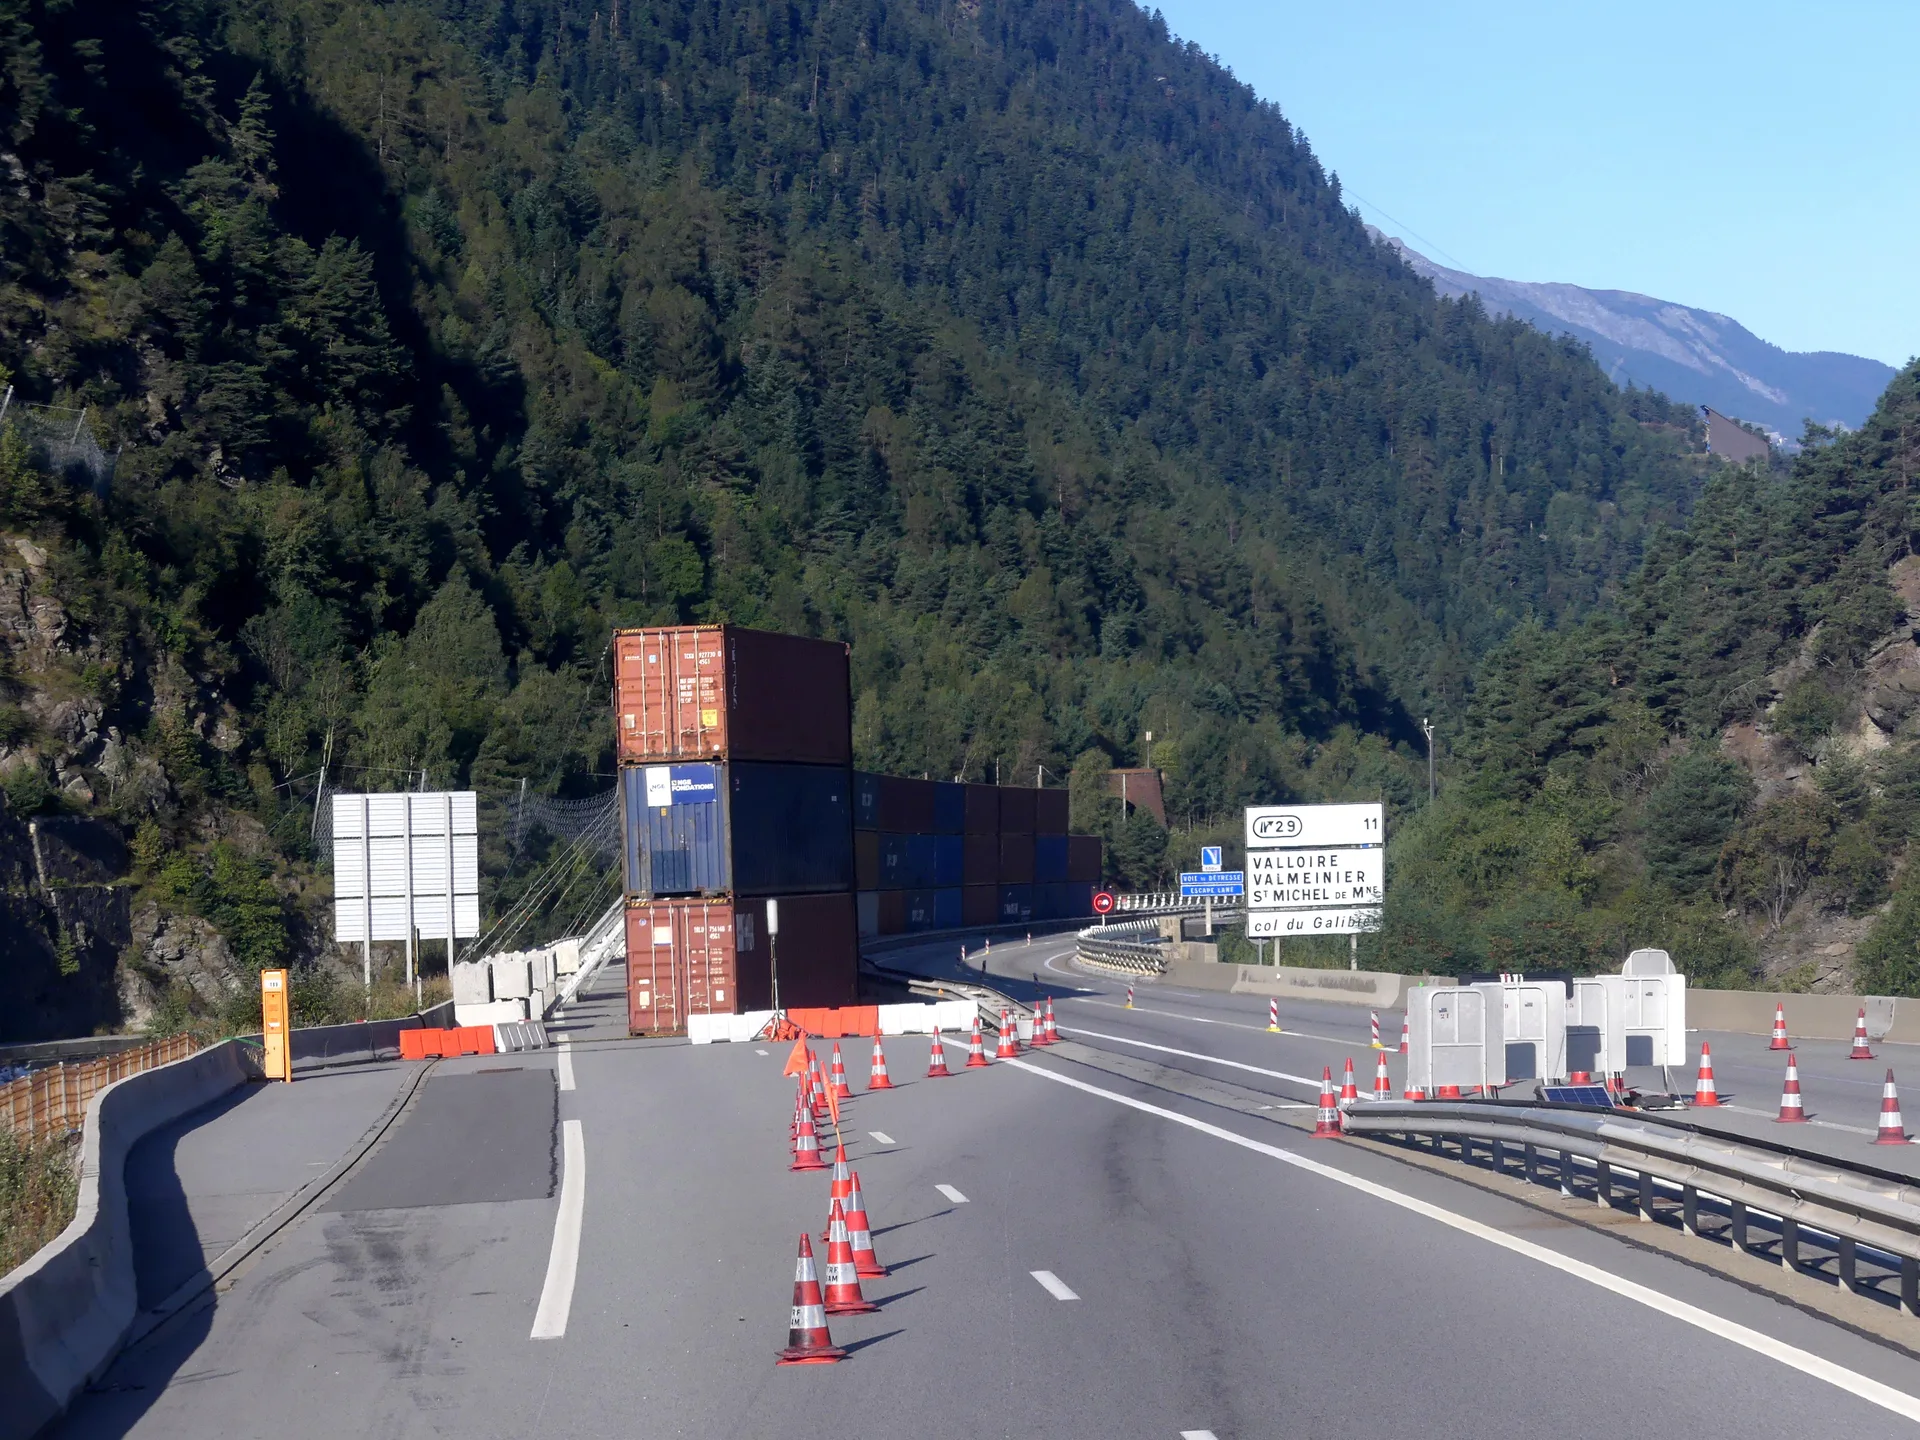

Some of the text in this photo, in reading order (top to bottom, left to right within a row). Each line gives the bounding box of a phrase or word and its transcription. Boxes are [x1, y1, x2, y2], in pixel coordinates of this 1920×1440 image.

[671, 783, 715, 792] FONDATIONS
[677, 778, 692, 786] NGE
[1275, 820, 1296, 833] 29
[1364, 817, 1378, 830] 11
[1253, 854, 1338, 869] VALLOIRE
[1253, 870, 1365, 886] VALMEINIER
[1273, 888, 1330, 902] MICHEL
[1335, 891, 1347, 899] DE
[1254, 918, 1278, 932] col
[1287, 917, 1304, 930] du
